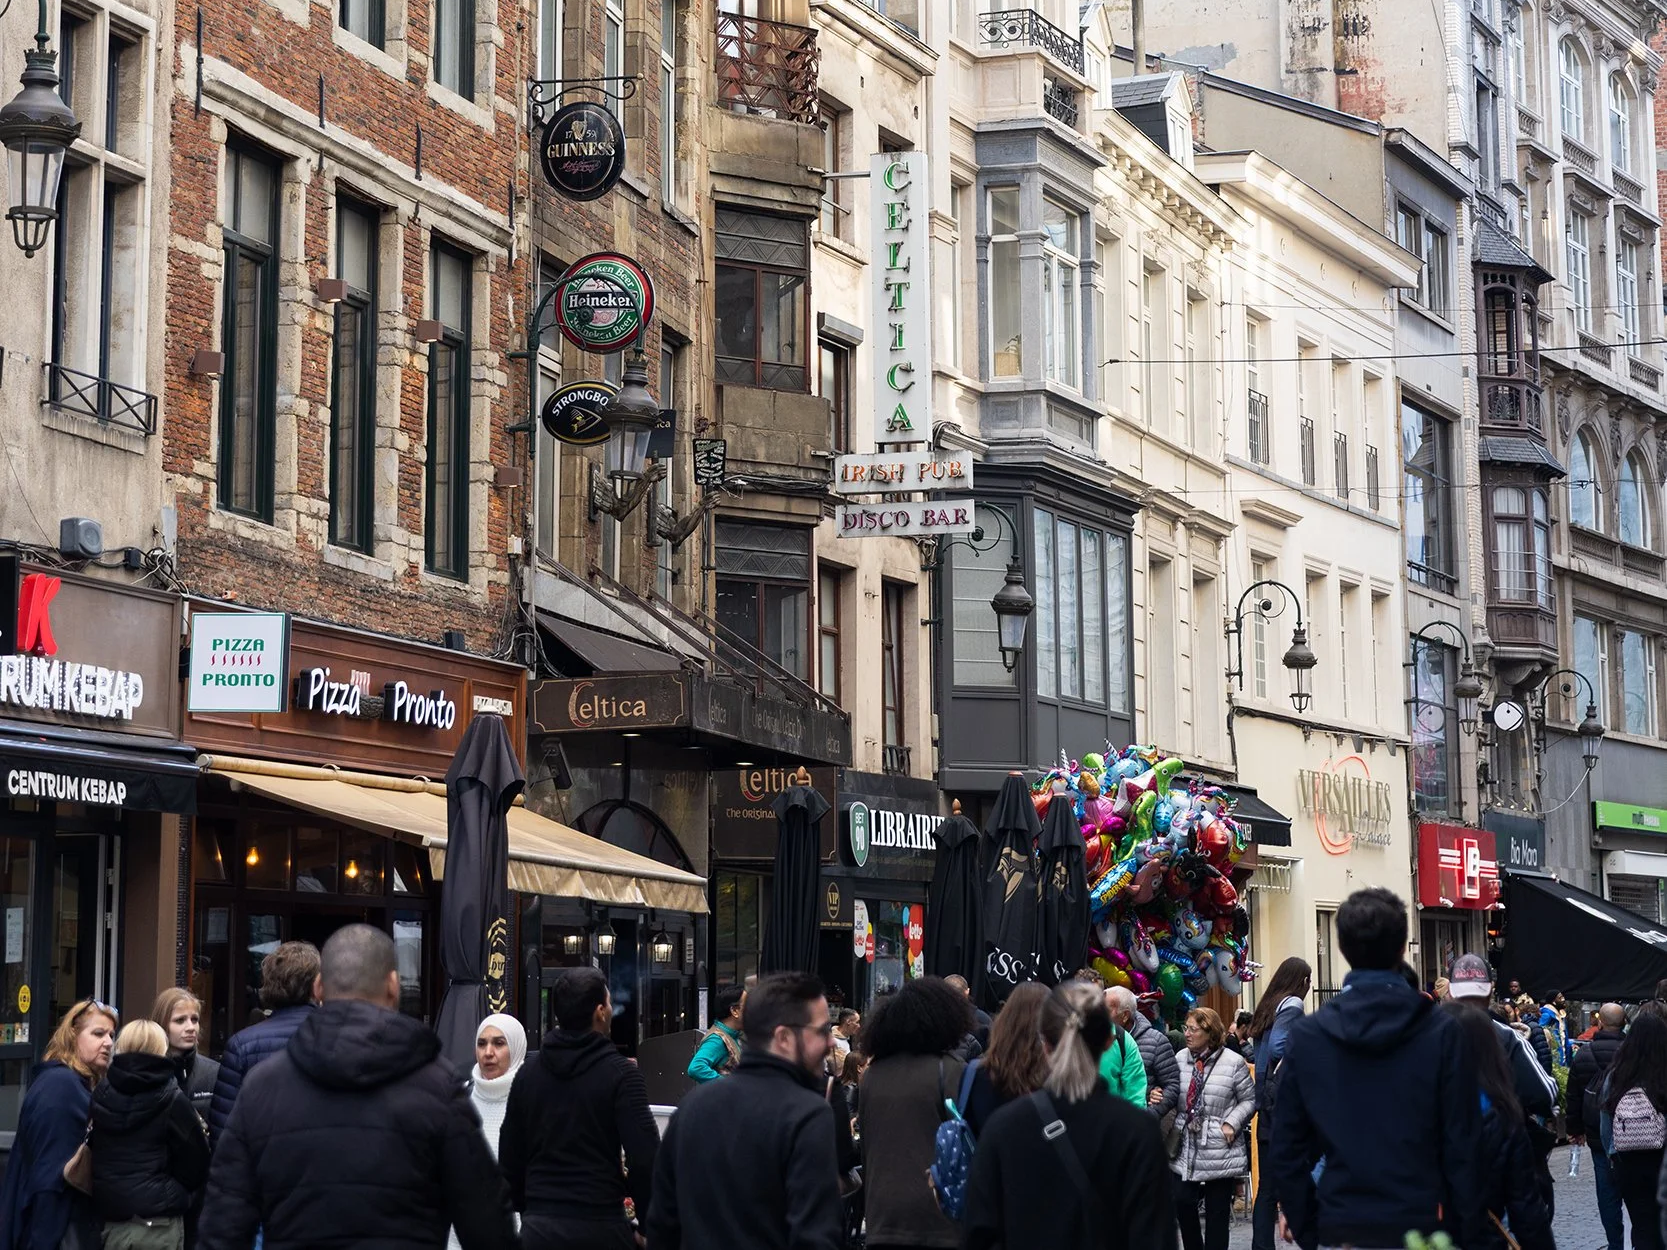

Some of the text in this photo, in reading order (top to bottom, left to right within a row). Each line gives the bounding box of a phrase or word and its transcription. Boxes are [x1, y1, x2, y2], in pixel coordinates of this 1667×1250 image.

[564, 131, 572, 139] 17
[546, 141, 616, 159] GUINNESS
[615, 267, 635, 288] Beer
[568, 293, 634, 309] Heineken
[884, 161, 915, 432] CELTICA
[612, 315, 633, 336] Beer
[551, 390, 610, 417] STRONGBO
[841, 461, 965, 483] IRISH PUB
[842, 508, 970, 530] DISCO BAR
[212, 638, 265, 652] PIZZA
[0, 654, 144, 720] RUM KEBAP
[202, 673, 275, 687] PRONTO
[308, 667, 456, 730] Pizza Pronto
[568, 681, 647, 728] Celtica
[8, 769, 127, 806] CENTRUM KEBAP
[1299, 766, 1392, 833] VERSAILLES
[855, 812, 865, 824] BET
[828, 892, 839, 904] VIP
